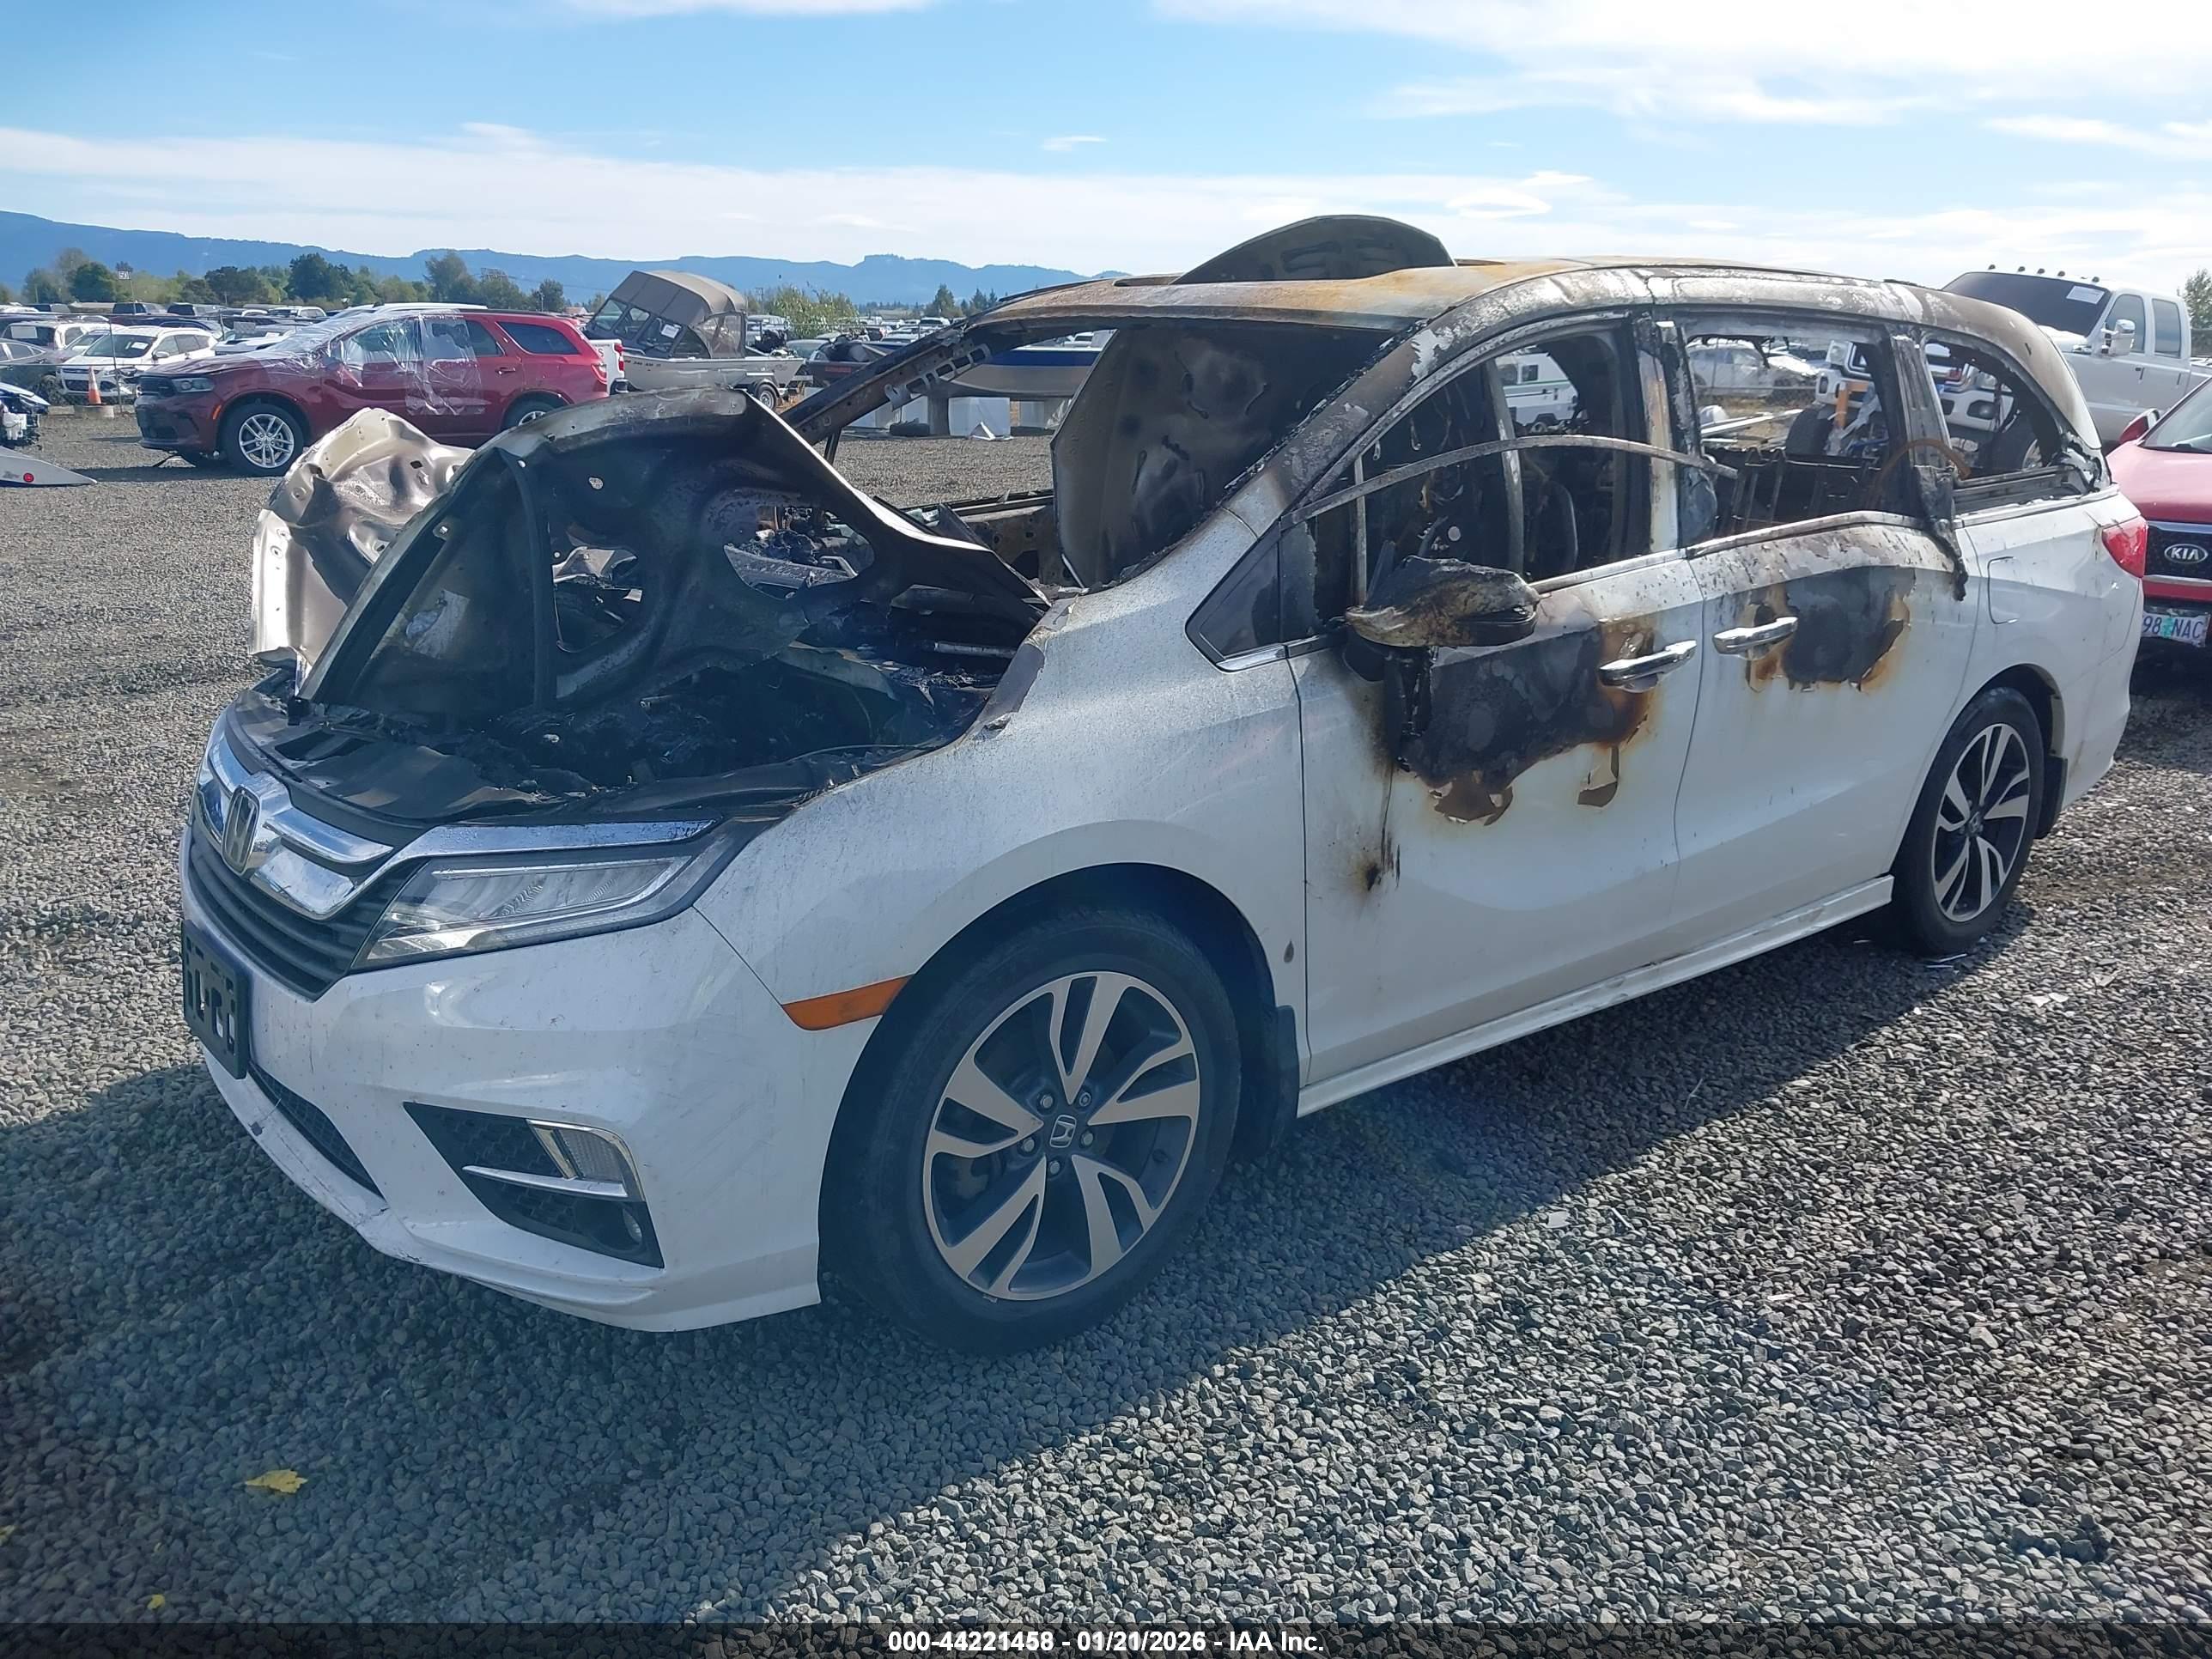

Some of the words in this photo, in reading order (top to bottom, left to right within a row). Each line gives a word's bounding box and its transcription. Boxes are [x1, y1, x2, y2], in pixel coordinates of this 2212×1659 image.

[2171, 547, 2199, 561] KIA
[2142, 616, 2162, 635] 98
[2171, 618, 2203, 640] NAC
